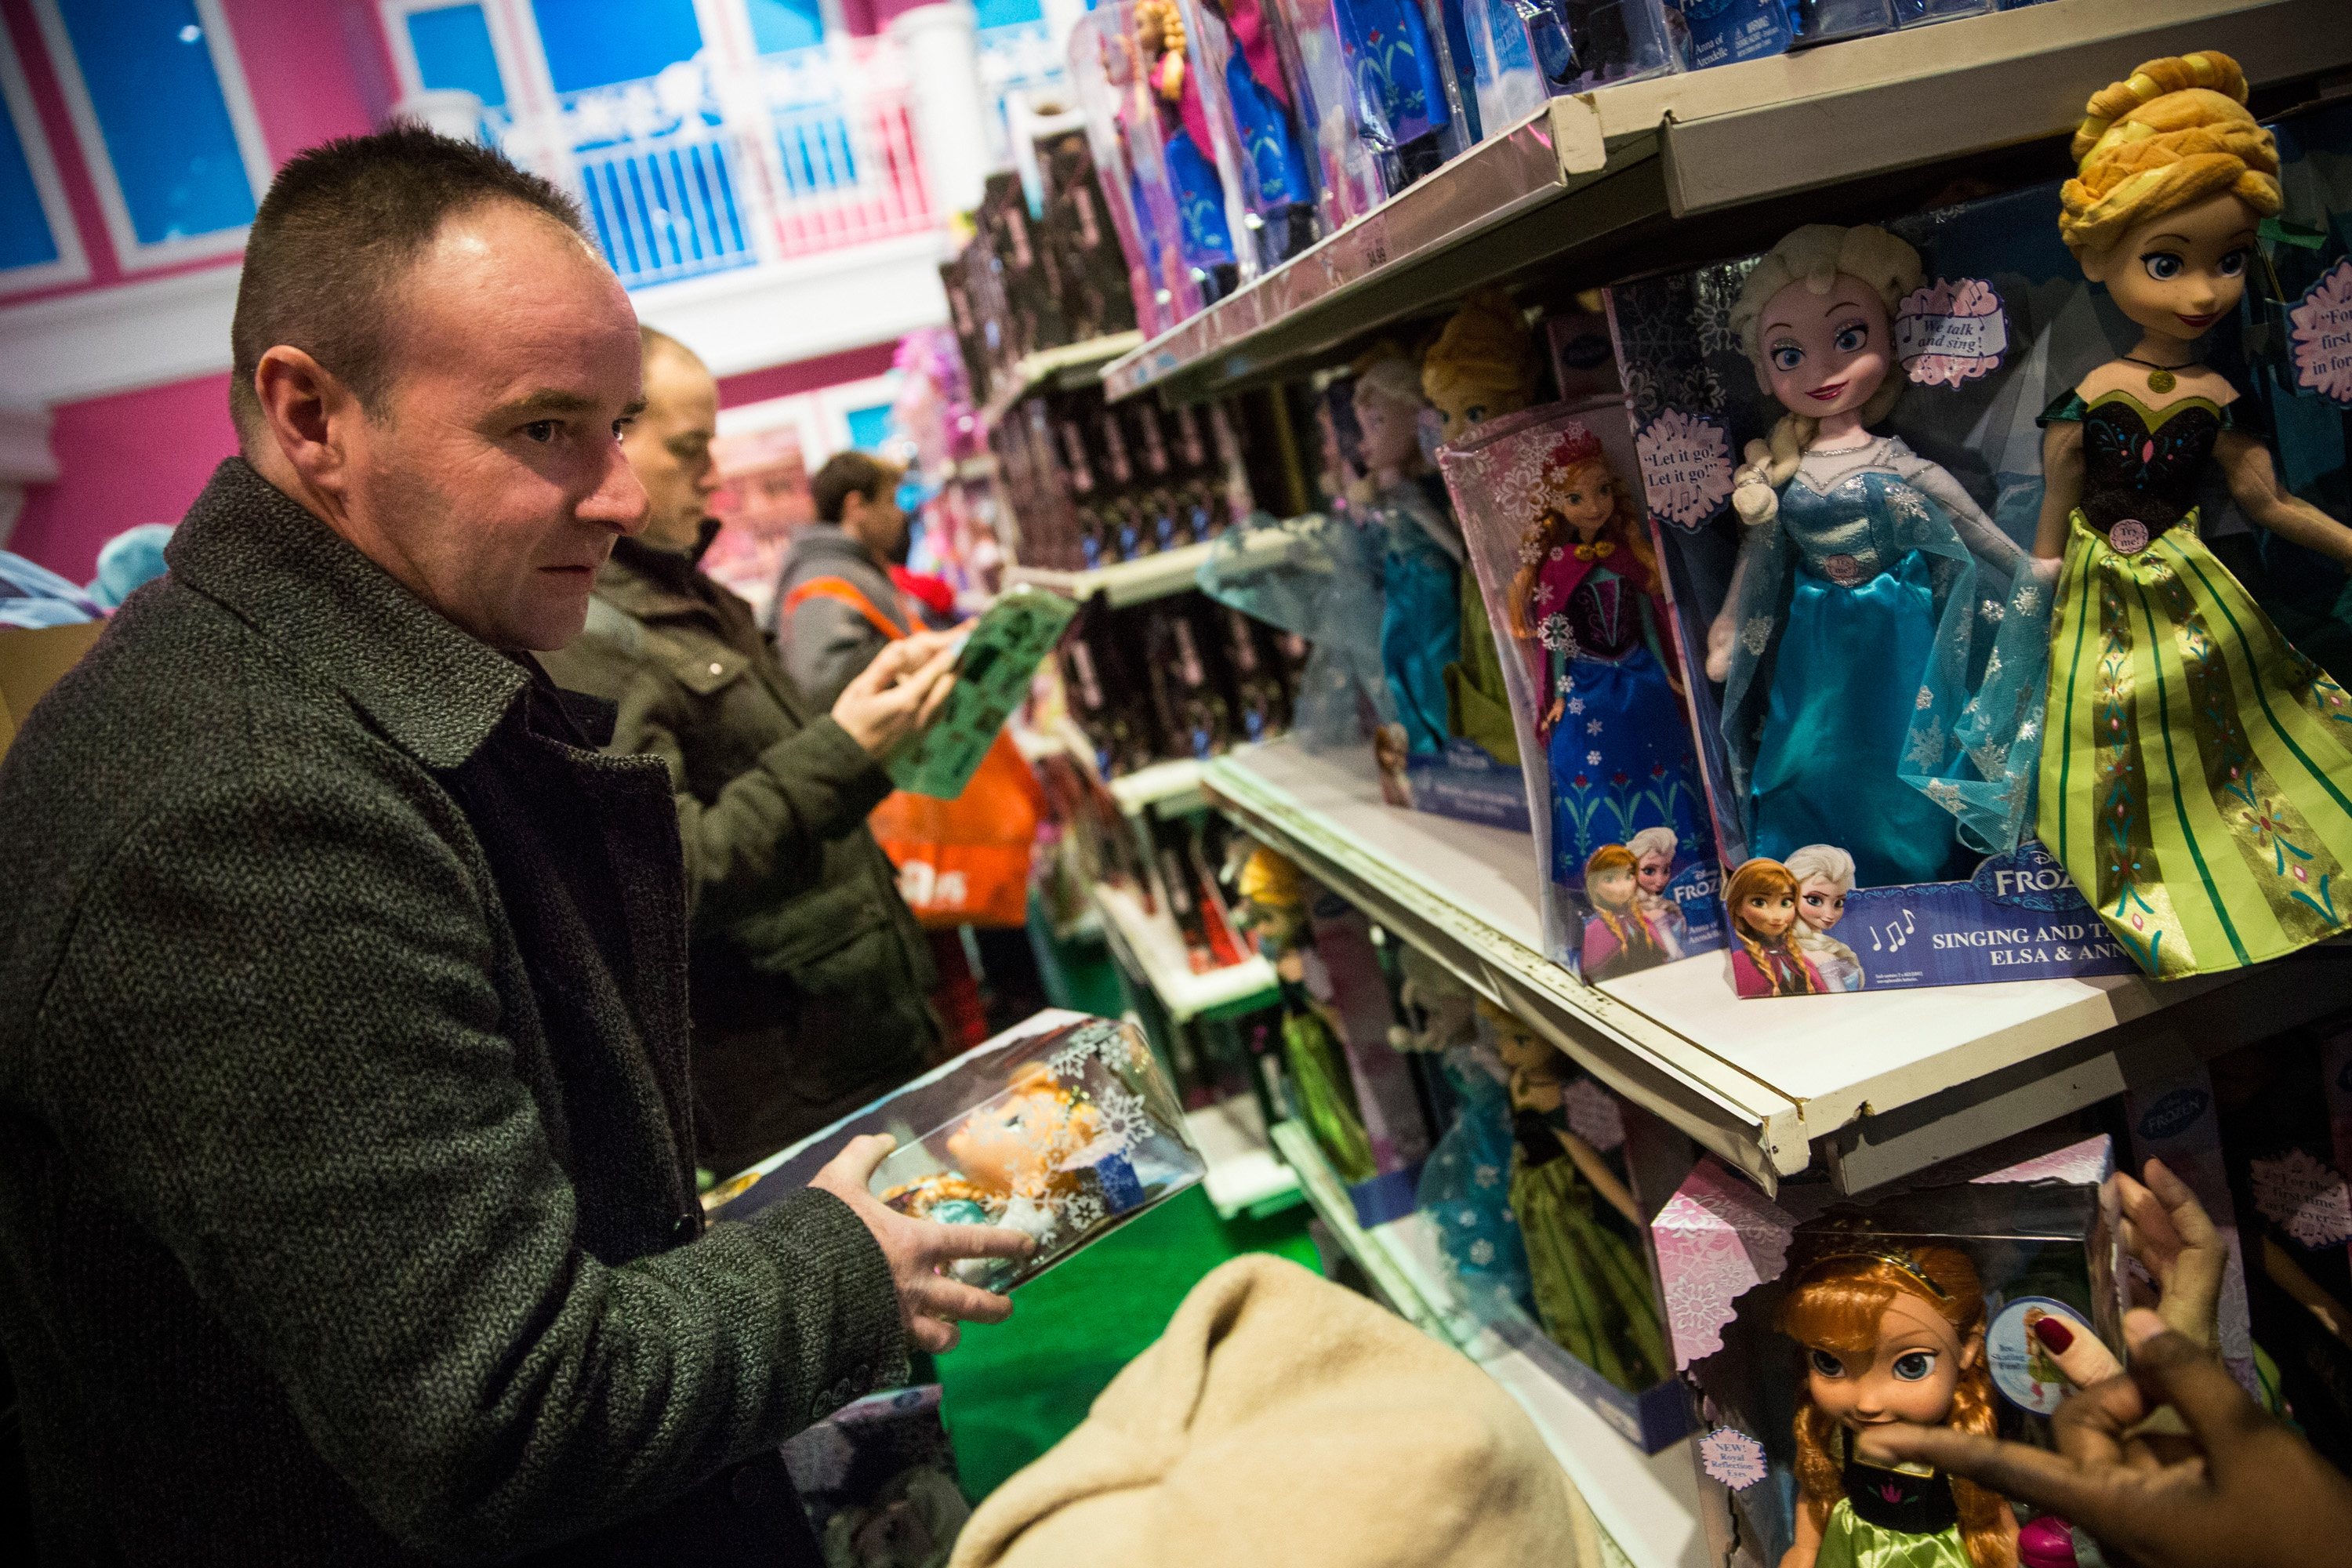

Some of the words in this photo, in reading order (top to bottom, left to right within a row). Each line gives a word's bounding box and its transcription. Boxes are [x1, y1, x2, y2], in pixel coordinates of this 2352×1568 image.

[1695, 39, 1715, 55] Anna
[1715, 31, 1724, 45] of
[1696, 47, 1729, 69] Arendelle
[1924, 320, 1944, 333] We
[1947, 323, 1974, 336] talk
[1918, 335, 1945, 347] and
[1946, 336, 1982, 353] sing!
[2321, 332, 2352, 350] first
[2313, 361, 2327, 376] in
[1679, 449, 1689, 463] it
[1693, 444, 1715, 463] go!
[1648, 473, 1671, 486] Let
[1675, 470, 1685, 482] it
[2120, 528, 2136, 536] Try
[1932, 927, 2029, 949] SINGING
[2035, 924, 2085, 942] AND
[1990, 948, 2050, 966] ELSA
[2054, 946, 2073, 961] &
[2304, 1195, 2336, 1209] time
[1715, 1443, 1746, 1452] NEW!
